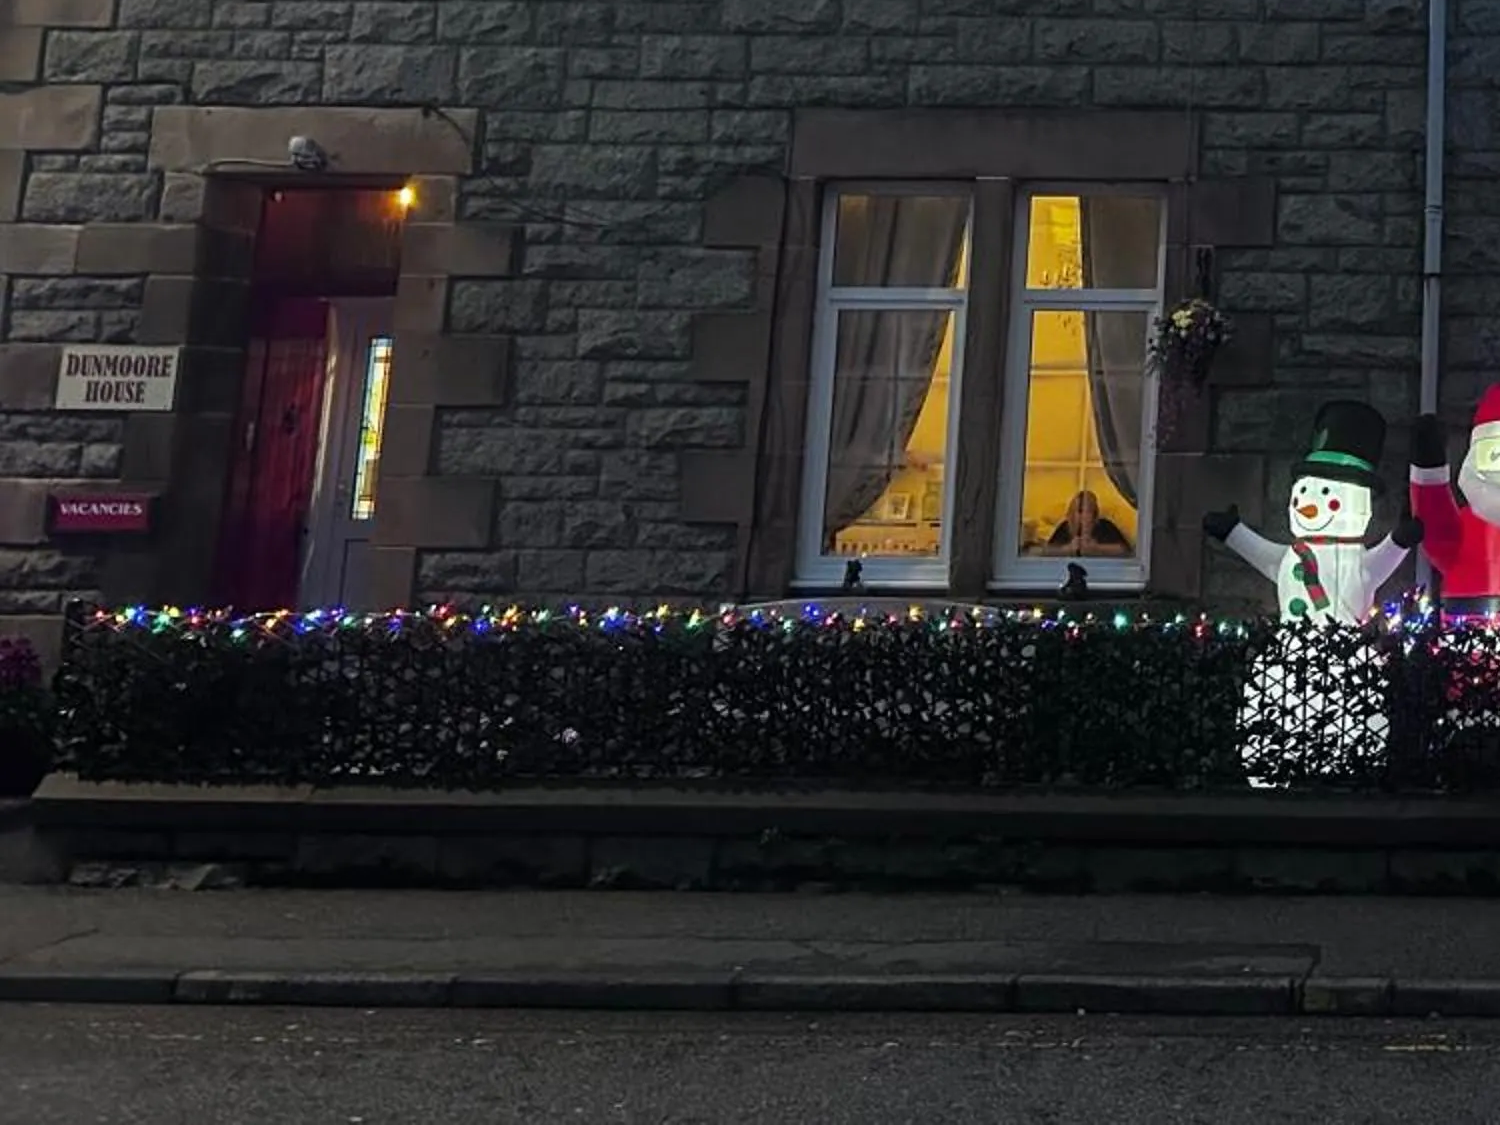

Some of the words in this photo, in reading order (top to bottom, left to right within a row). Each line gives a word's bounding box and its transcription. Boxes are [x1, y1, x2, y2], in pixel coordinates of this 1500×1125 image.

[66, 354, 173, 376] DUNMOORE
[85, 381, 145, 403] HOUSE
[60, 502, 143, 515] VACANCIES
